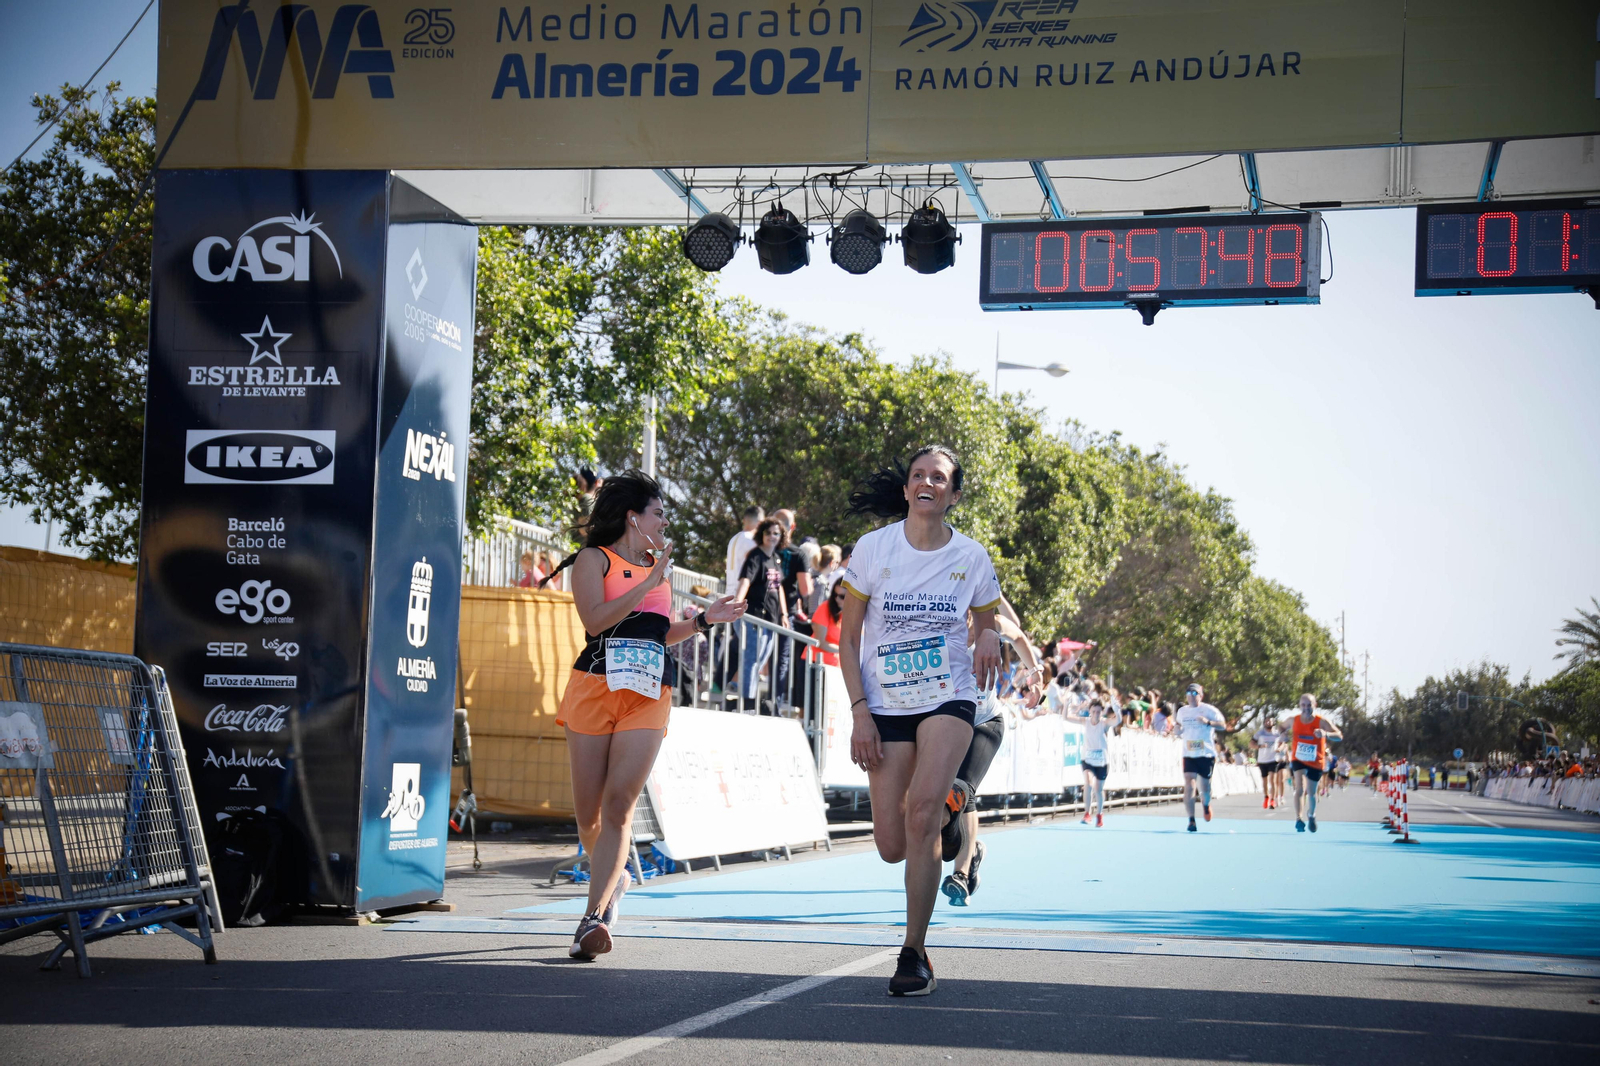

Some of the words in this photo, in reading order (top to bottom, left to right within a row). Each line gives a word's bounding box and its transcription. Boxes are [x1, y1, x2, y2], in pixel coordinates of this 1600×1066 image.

[403, 8, 455, 45] 25
[496, 3, 637, 43] Medio
[660, 0, 862, 40] Maratón
[989, 18, 1071, 36] SERIES
[402, 46, 455, 59] EDICIÓN
[981, 37, 1034, 51] RUTA
[1037, 33, 1118, 49] RUNNING
[491, 48, 700, 100] Almería
[712, 46, 862, 97] 2024
[895, 60, 1018, 91] RAMÓN
[1035, 61, 1115, 88] RUIZ
[1129, 49, 1301, 84] ANDÚJAR
[192, 235, 310, 283] CASI
[404, 302, 461, 344] COOPERACIÓN
[404, 320, 425, 343] 2005
[187, 365, 341, 386] ESTRELLA
[222, 386, 242, 397] DE
[243, 386, 306, 397] LEVANTE
[205, 445, 318, 468] IKEA
[227, 517, 285, 532] Barceló
[226, 534, 264, 549] Cabo
[267, 534, 287, 549] de
[226, 550, 261, 565] Gata
[215, 579, 291, 624] ego
[882, 601, 927, 612] Almería
[928, 602, 957, 613] 2024
[883, 592, 914, 601] Medio
[918, 593, 958, 602] Maratón
[262, 615, 277, 625] sport
[278, 615, 295, 624] center
[206, 642, 248, 657] SER
[613, 647, 660, 670] 5334
[396, 656, 437, 680] ALMERÍA
[628, 662, 648, 670] MARINA
[883, 648, 943, 676] 5806
[204, 676, 218, 686] La
[219, 676, 239, 686] Voz
[239, 676, 253, 686] de
[253, 676, 296, 687] Almería
[903, 670, 924, 679] ELENA
[204, 703, 291, 733] Coca-Cola
[202, 746, 287, 770] Andalucía
